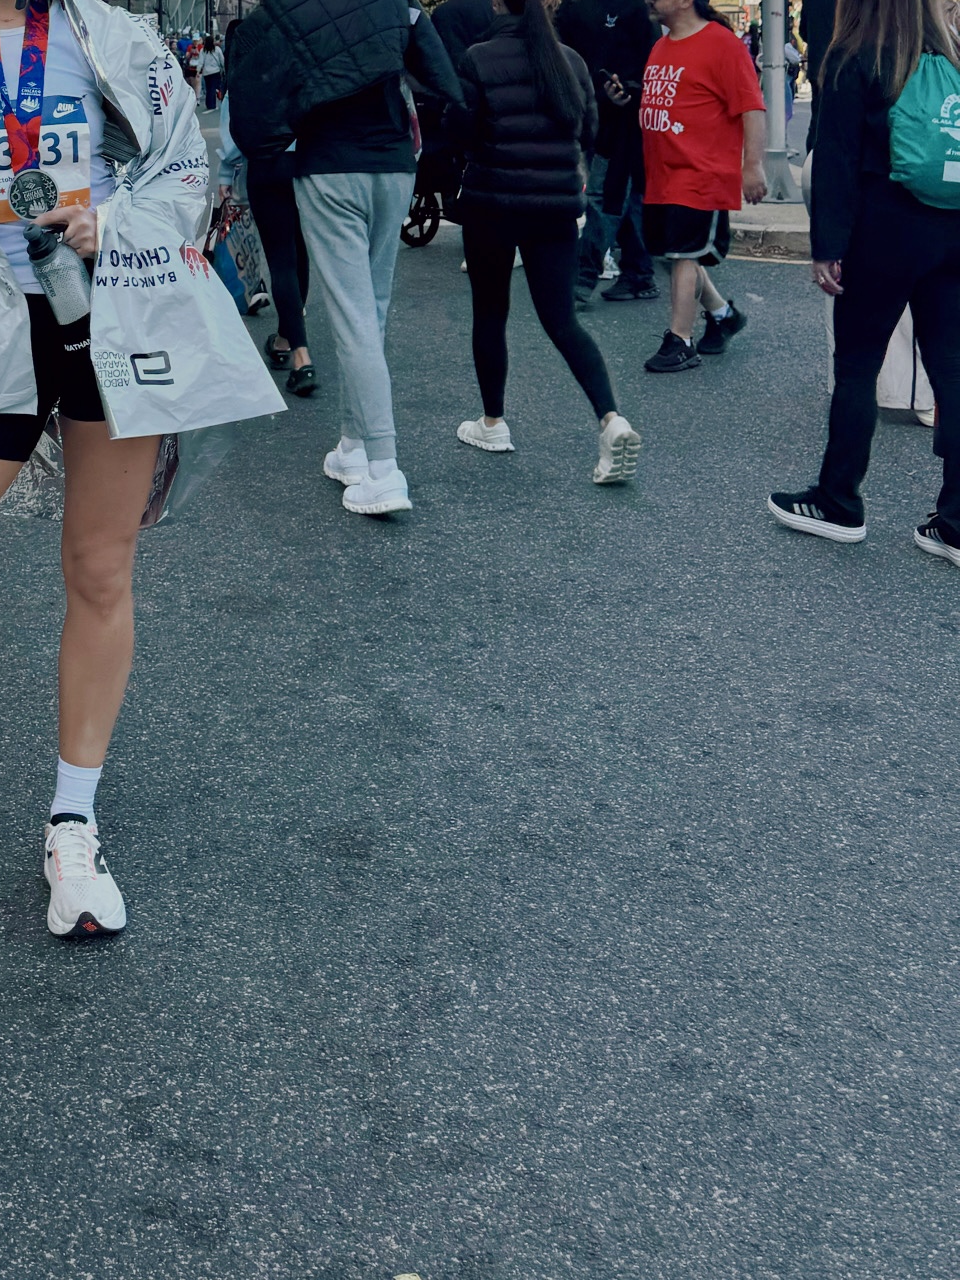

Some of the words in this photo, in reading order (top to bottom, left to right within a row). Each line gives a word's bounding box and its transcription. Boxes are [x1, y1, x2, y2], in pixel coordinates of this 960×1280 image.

[643, 65, 685, 82] TEAM
[57, 103, 75, 113] RUN
[644, 107, 671, 132] CLUB
[123, 276, 139, 288] OF
[139, 271, 178, 288] BANK
[97, 369, 130, 379] WORLD
